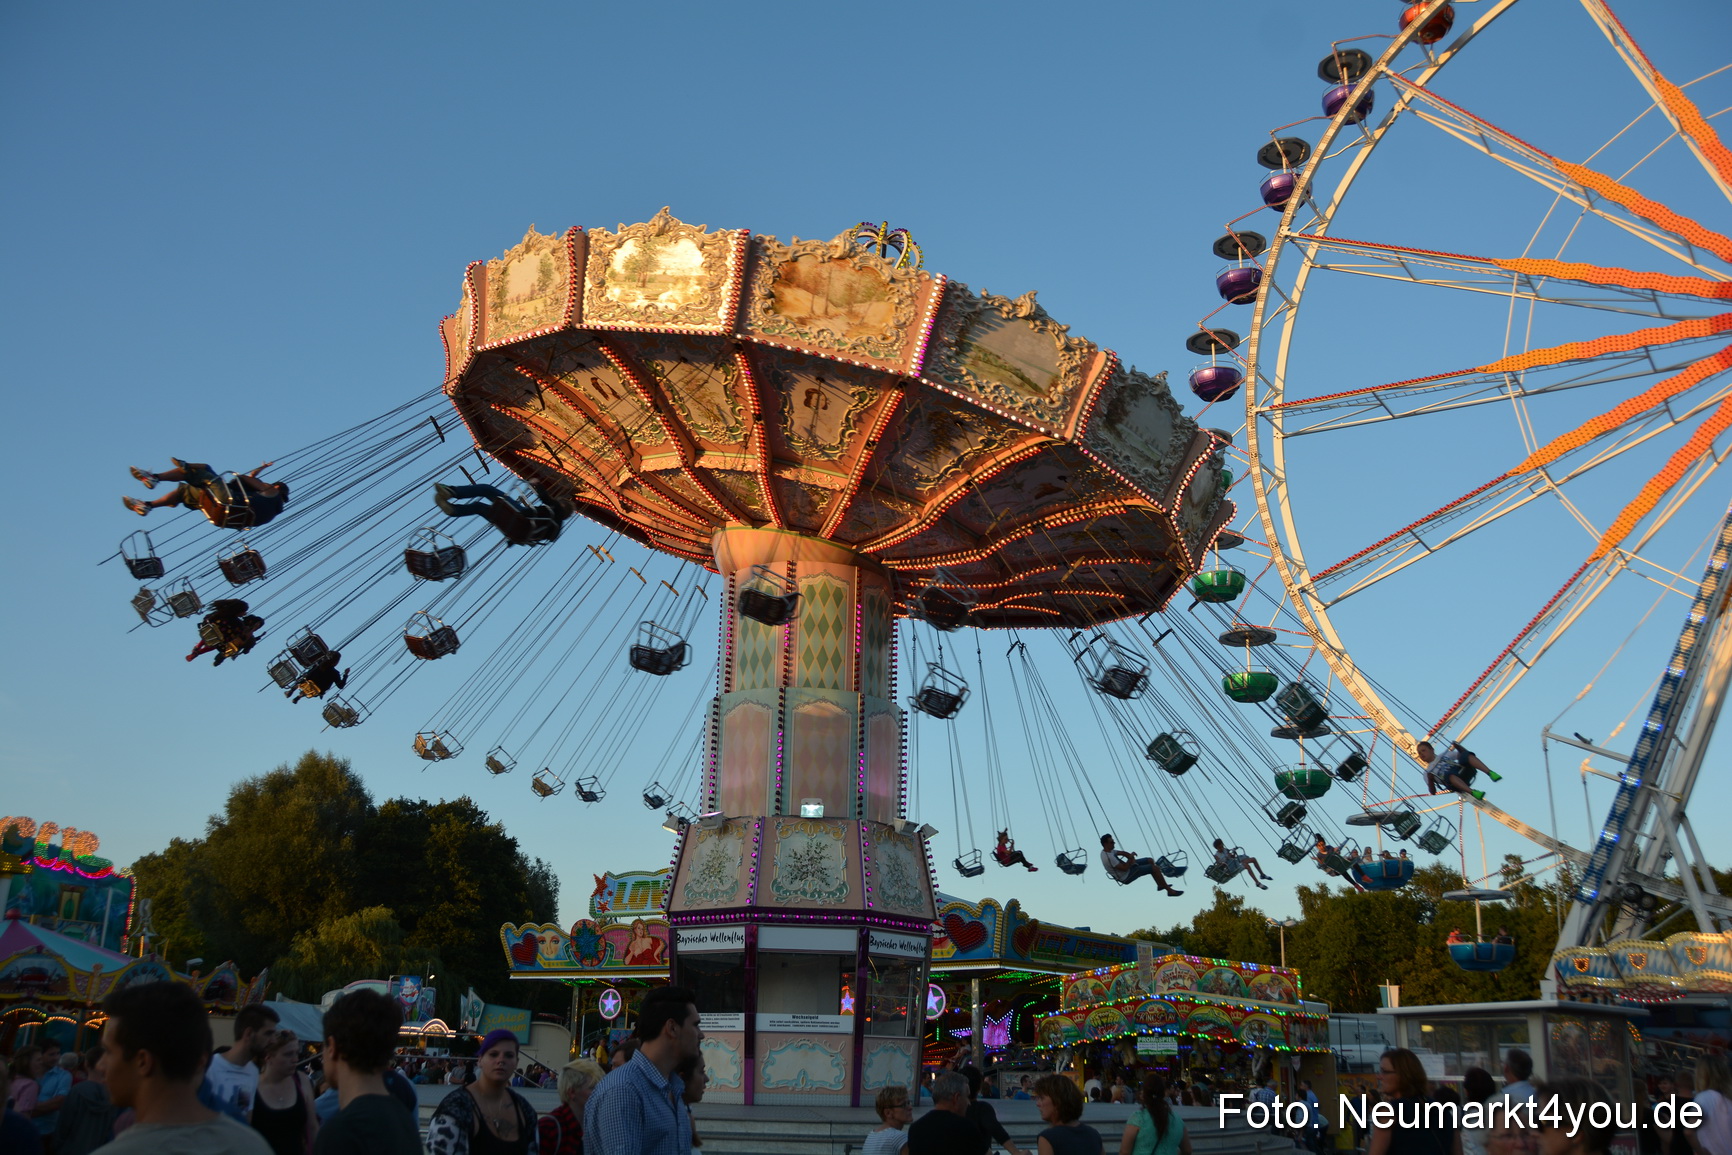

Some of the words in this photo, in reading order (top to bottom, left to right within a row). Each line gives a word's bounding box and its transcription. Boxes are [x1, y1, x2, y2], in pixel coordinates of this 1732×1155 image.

[677, 933, 708, 946] Bayrischer
[710, 931, 744, 944] Wellenflug
[870, 935, 897, 949] Bayrischer
[899, 939, 927, 955] Wellenflug
